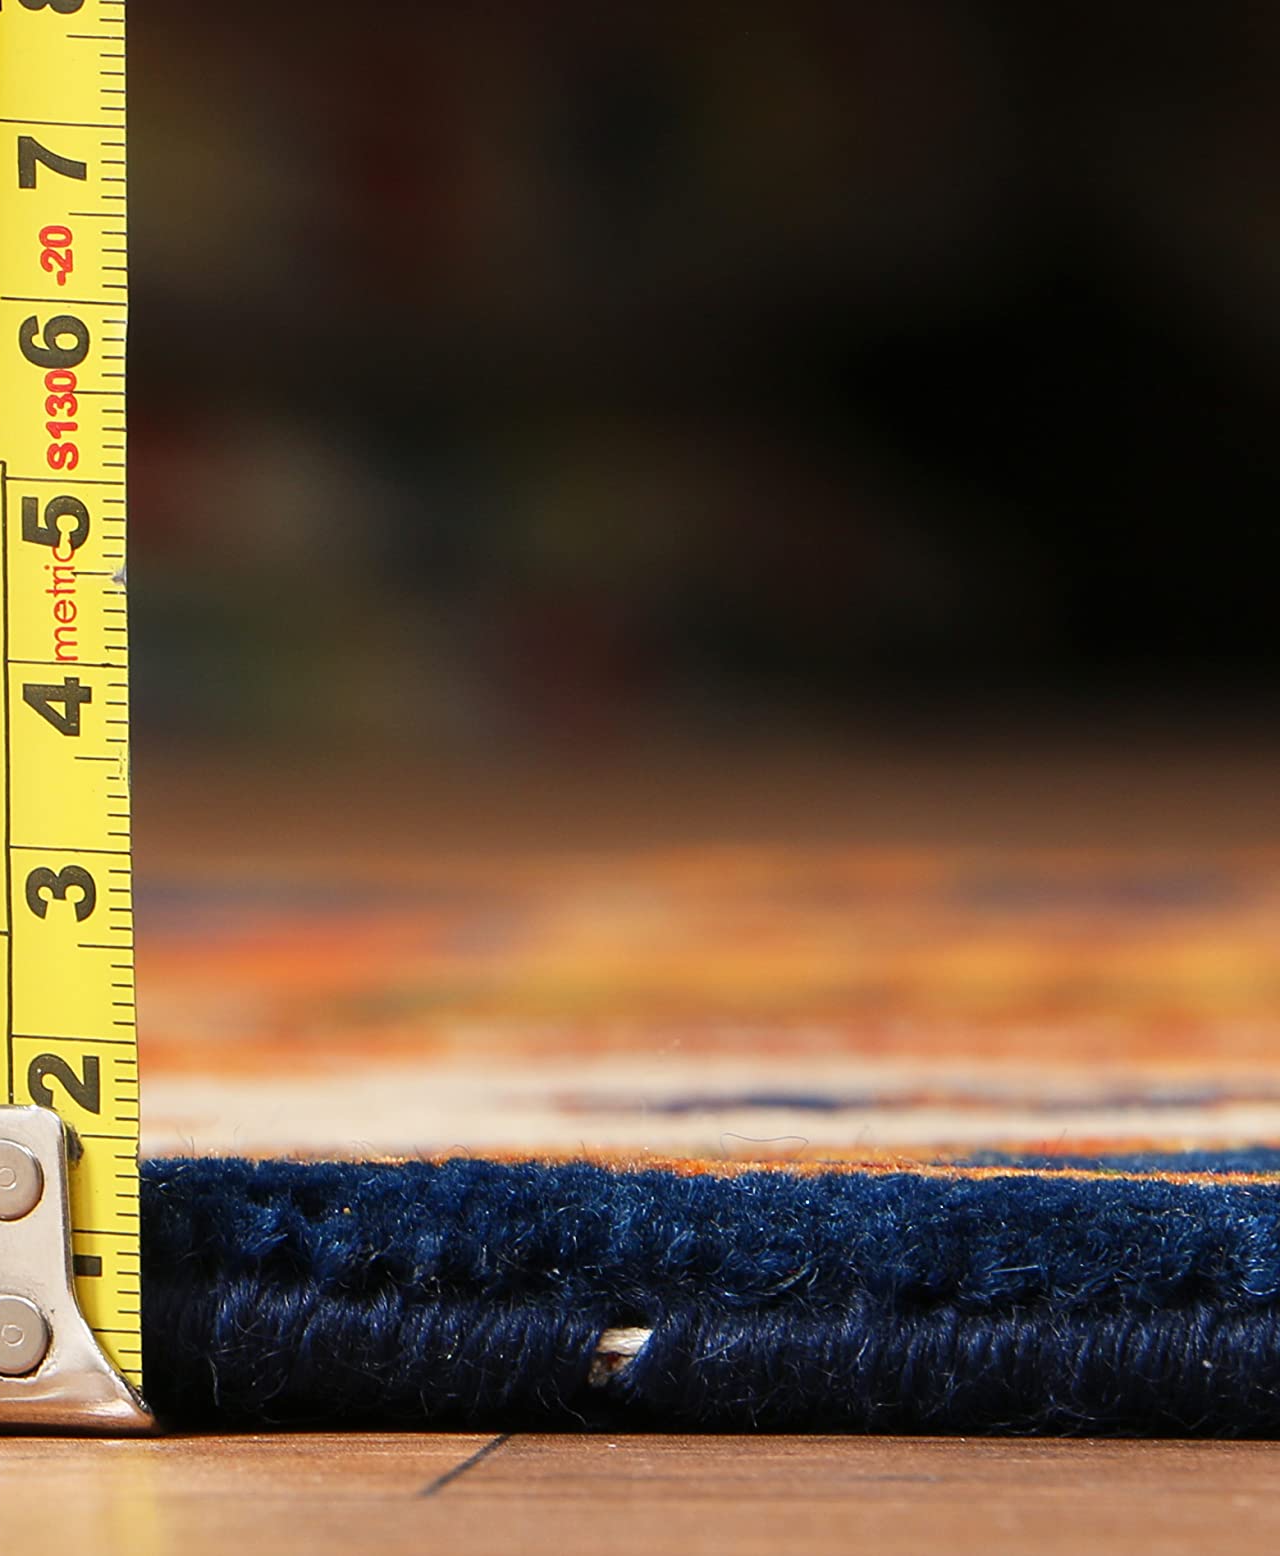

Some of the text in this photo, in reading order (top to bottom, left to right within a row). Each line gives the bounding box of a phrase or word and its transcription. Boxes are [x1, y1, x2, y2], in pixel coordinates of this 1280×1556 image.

[17, 136, 87, 189] 7
[18, 315, 90, 370] 6
[38, 225, 79, 471] S130 -20
[22, 495, 90, 550] 5
[45, 539, 78, 661] metric
[22, 676, 92, 736] 4
[25, 865, 97, 922] 3
[27, 1053, 100, 1115] 2
